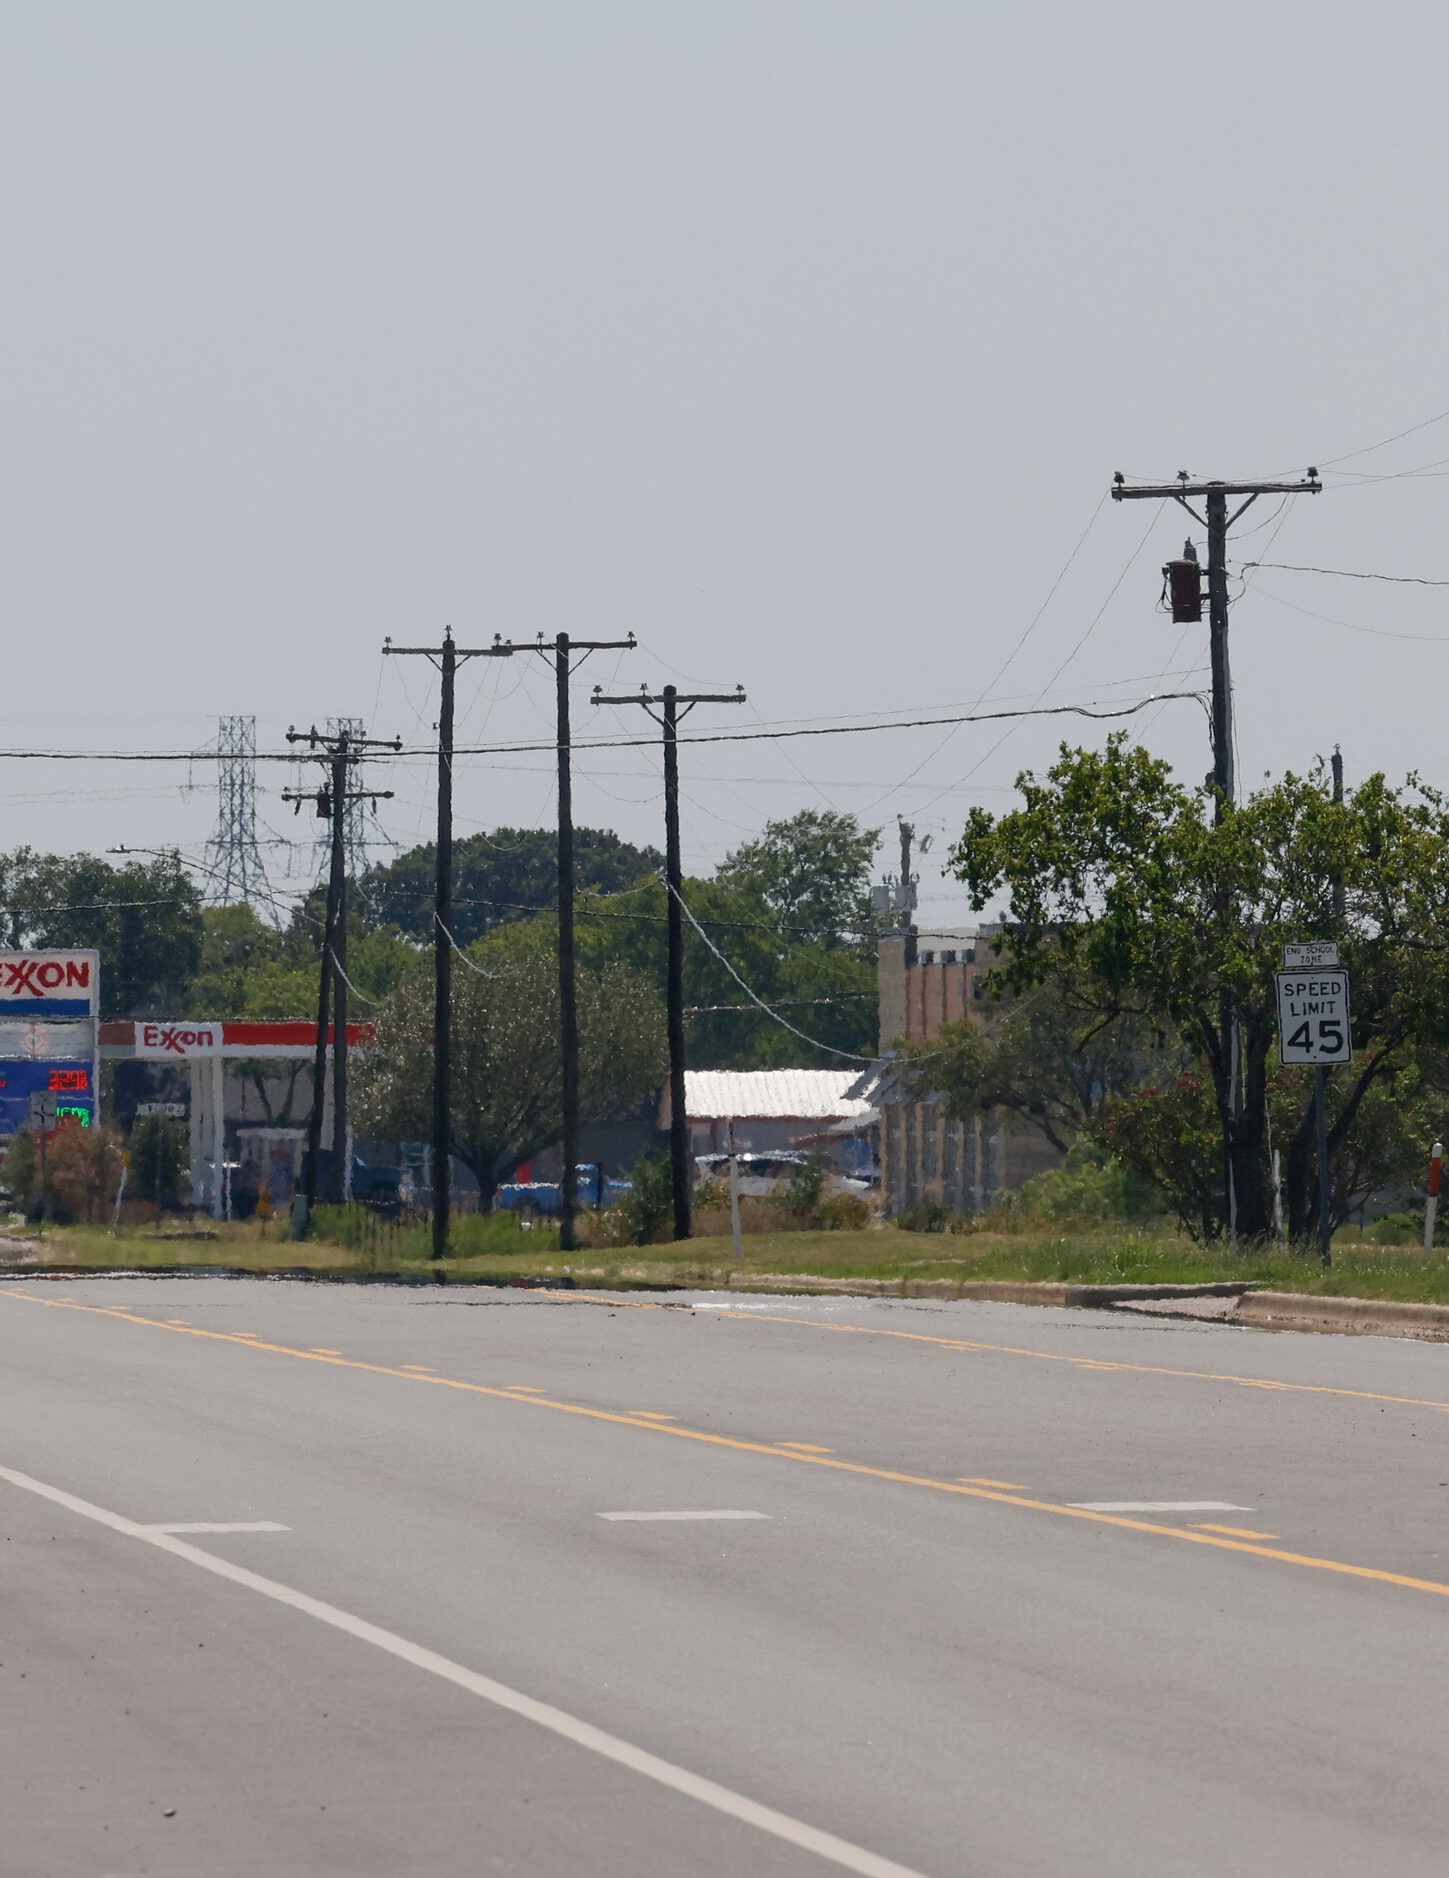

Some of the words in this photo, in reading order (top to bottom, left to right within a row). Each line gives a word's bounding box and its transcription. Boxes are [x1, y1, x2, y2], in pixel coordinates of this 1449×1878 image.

[1286, 947, 1301, 955] END
[1306, 945, 1335, 954] SCHOOL
[1300, 955, 1322, 964] ZONE
[1284, 982, 1341, 997] SPEED
[1290, 1001, 1336, 1017] LIMIT
[143, 1025, 213, 1054] Exxon
[1287, 1020, 1344, 1054] 45
